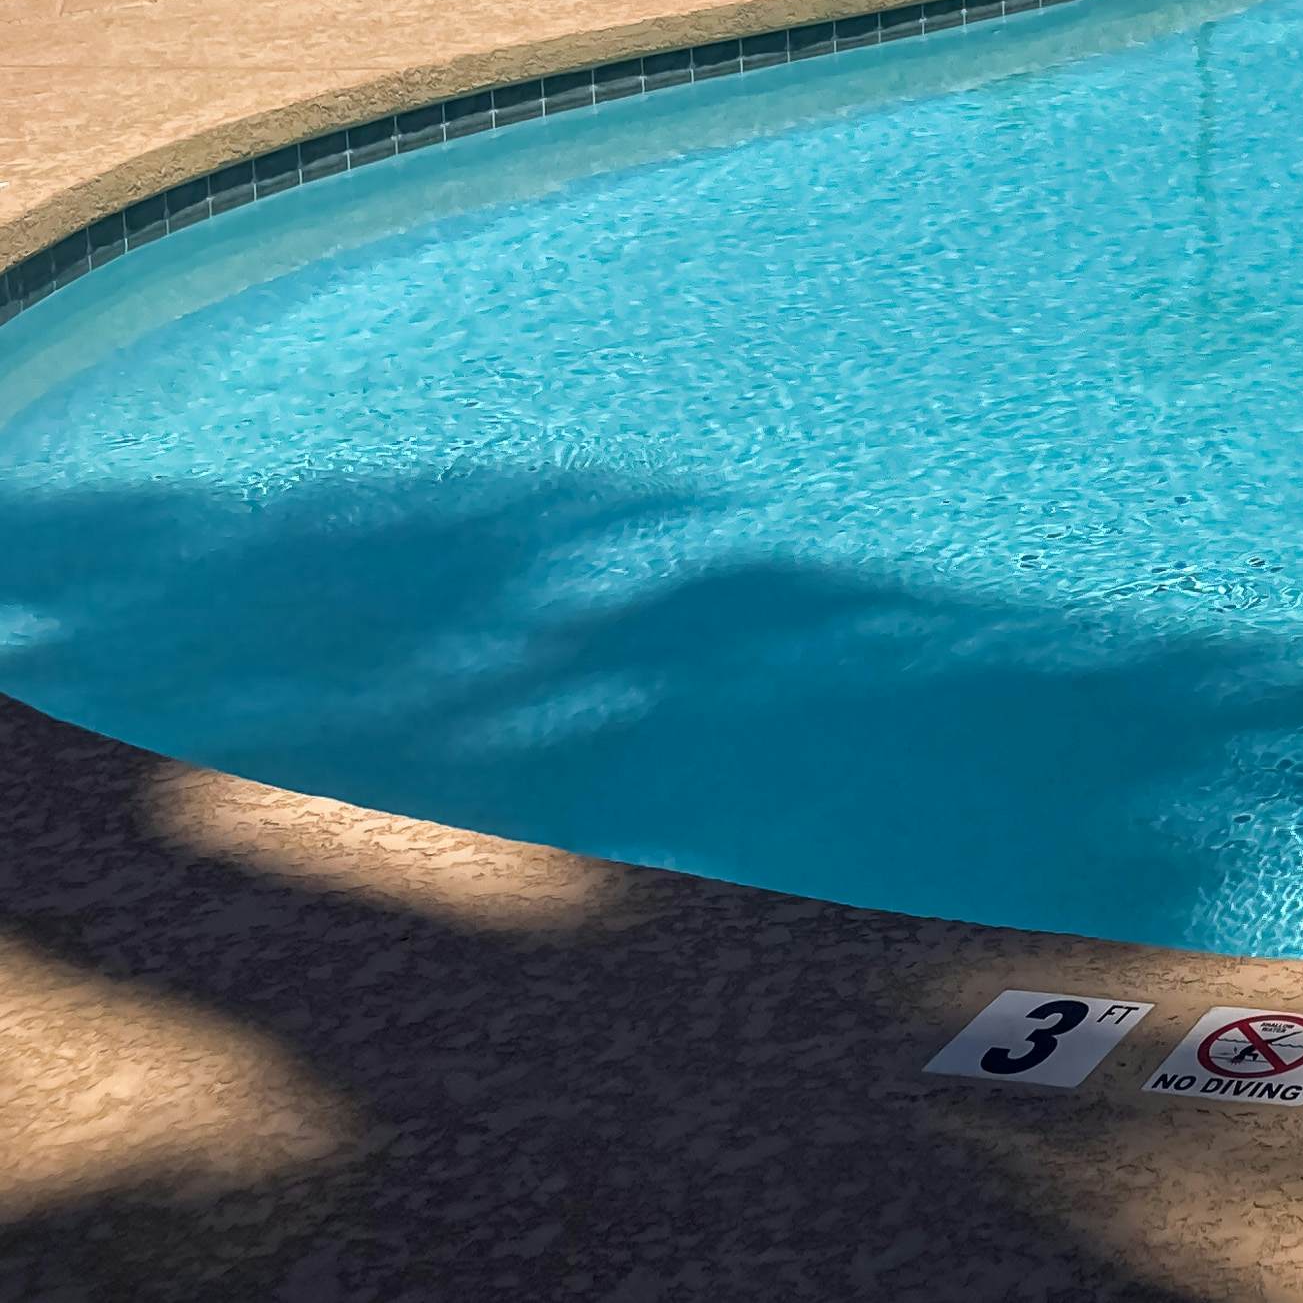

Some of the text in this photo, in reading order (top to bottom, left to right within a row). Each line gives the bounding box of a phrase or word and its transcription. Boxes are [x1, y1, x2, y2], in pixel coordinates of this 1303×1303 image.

[980, 1000, 1140, 1075] 3 FT
[1151, 1073, 1303, 1101] NO DIVING
